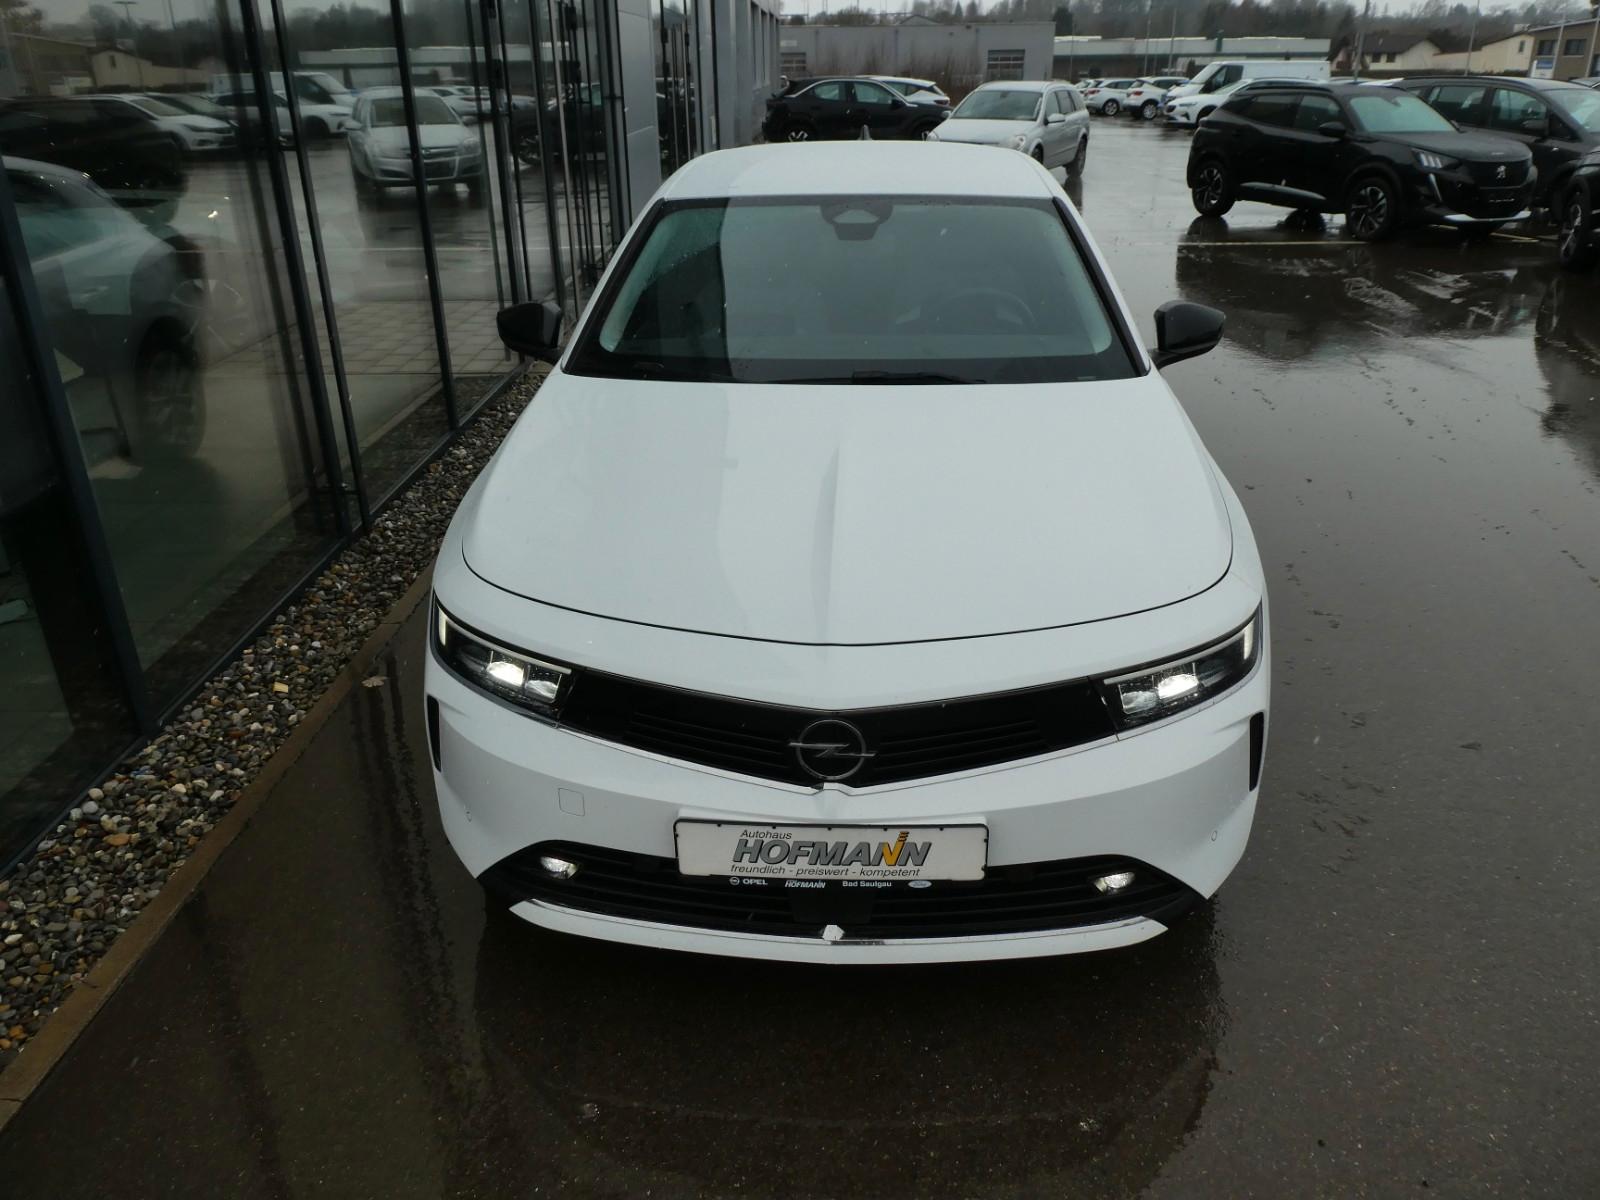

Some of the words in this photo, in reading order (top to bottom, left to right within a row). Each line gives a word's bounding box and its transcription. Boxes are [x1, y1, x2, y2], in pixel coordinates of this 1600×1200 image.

[740, 829, 792, 840] Autohaus
[733, 831, 932, 867] HOFMANN
[730, 864, 786, 875] freundlich
[795, 867, 849, 877] preiswert
[859, 867, 920, 878] kompetent
[742, 878, 768, 886] OPEL
[784, 880, 826, 889] HOFMANN
[842, 880, 858, 888] Bad
